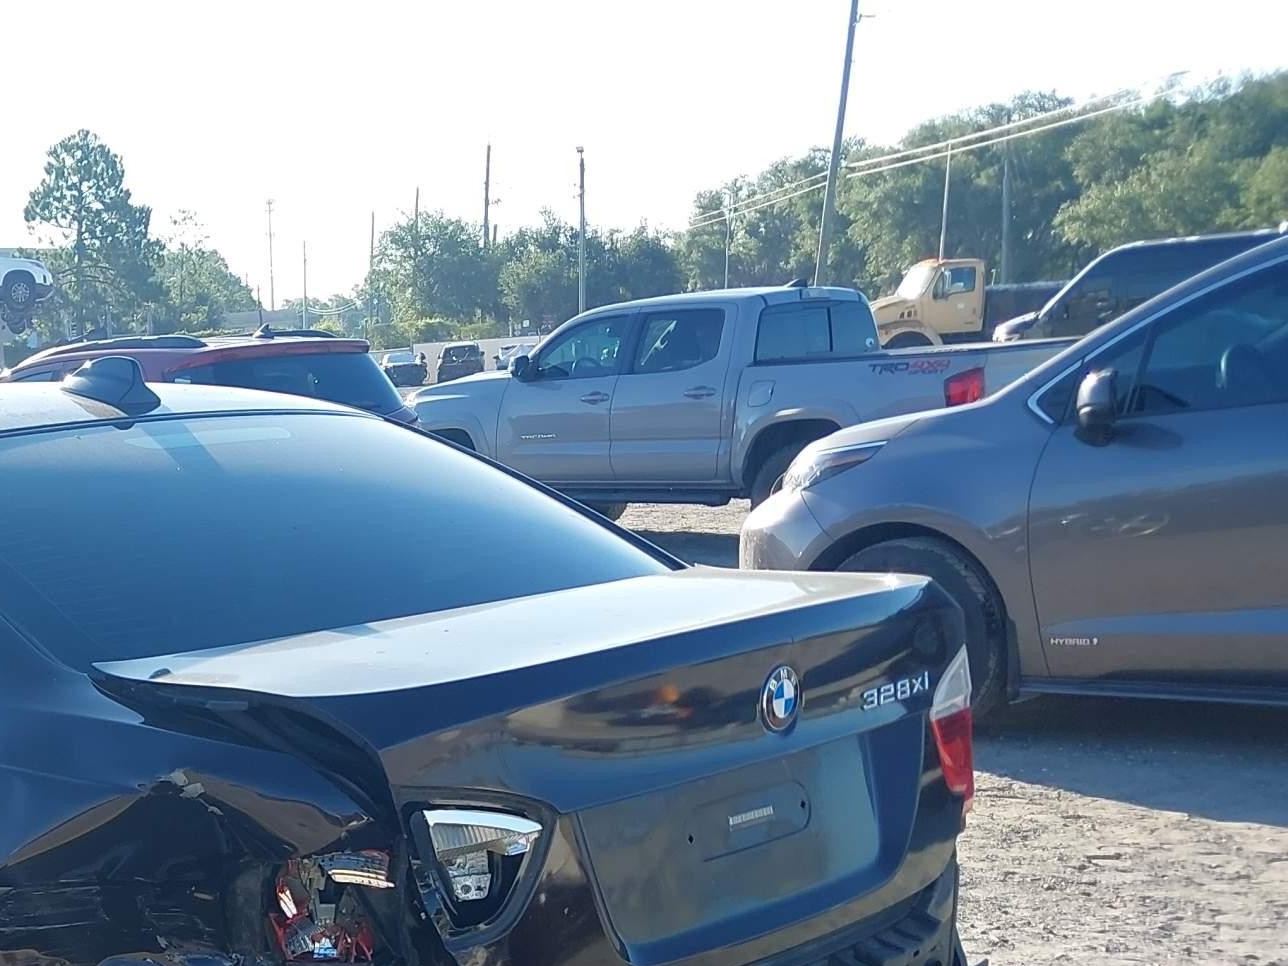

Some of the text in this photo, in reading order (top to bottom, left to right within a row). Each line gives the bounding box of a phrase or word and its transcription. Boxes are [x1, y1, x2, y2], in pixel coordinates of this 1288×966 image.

[868, 362, 910, 375] TRD
[1050, 637, 1090, 646] HYBRID
[862, 671, 929, 710] 328xi
